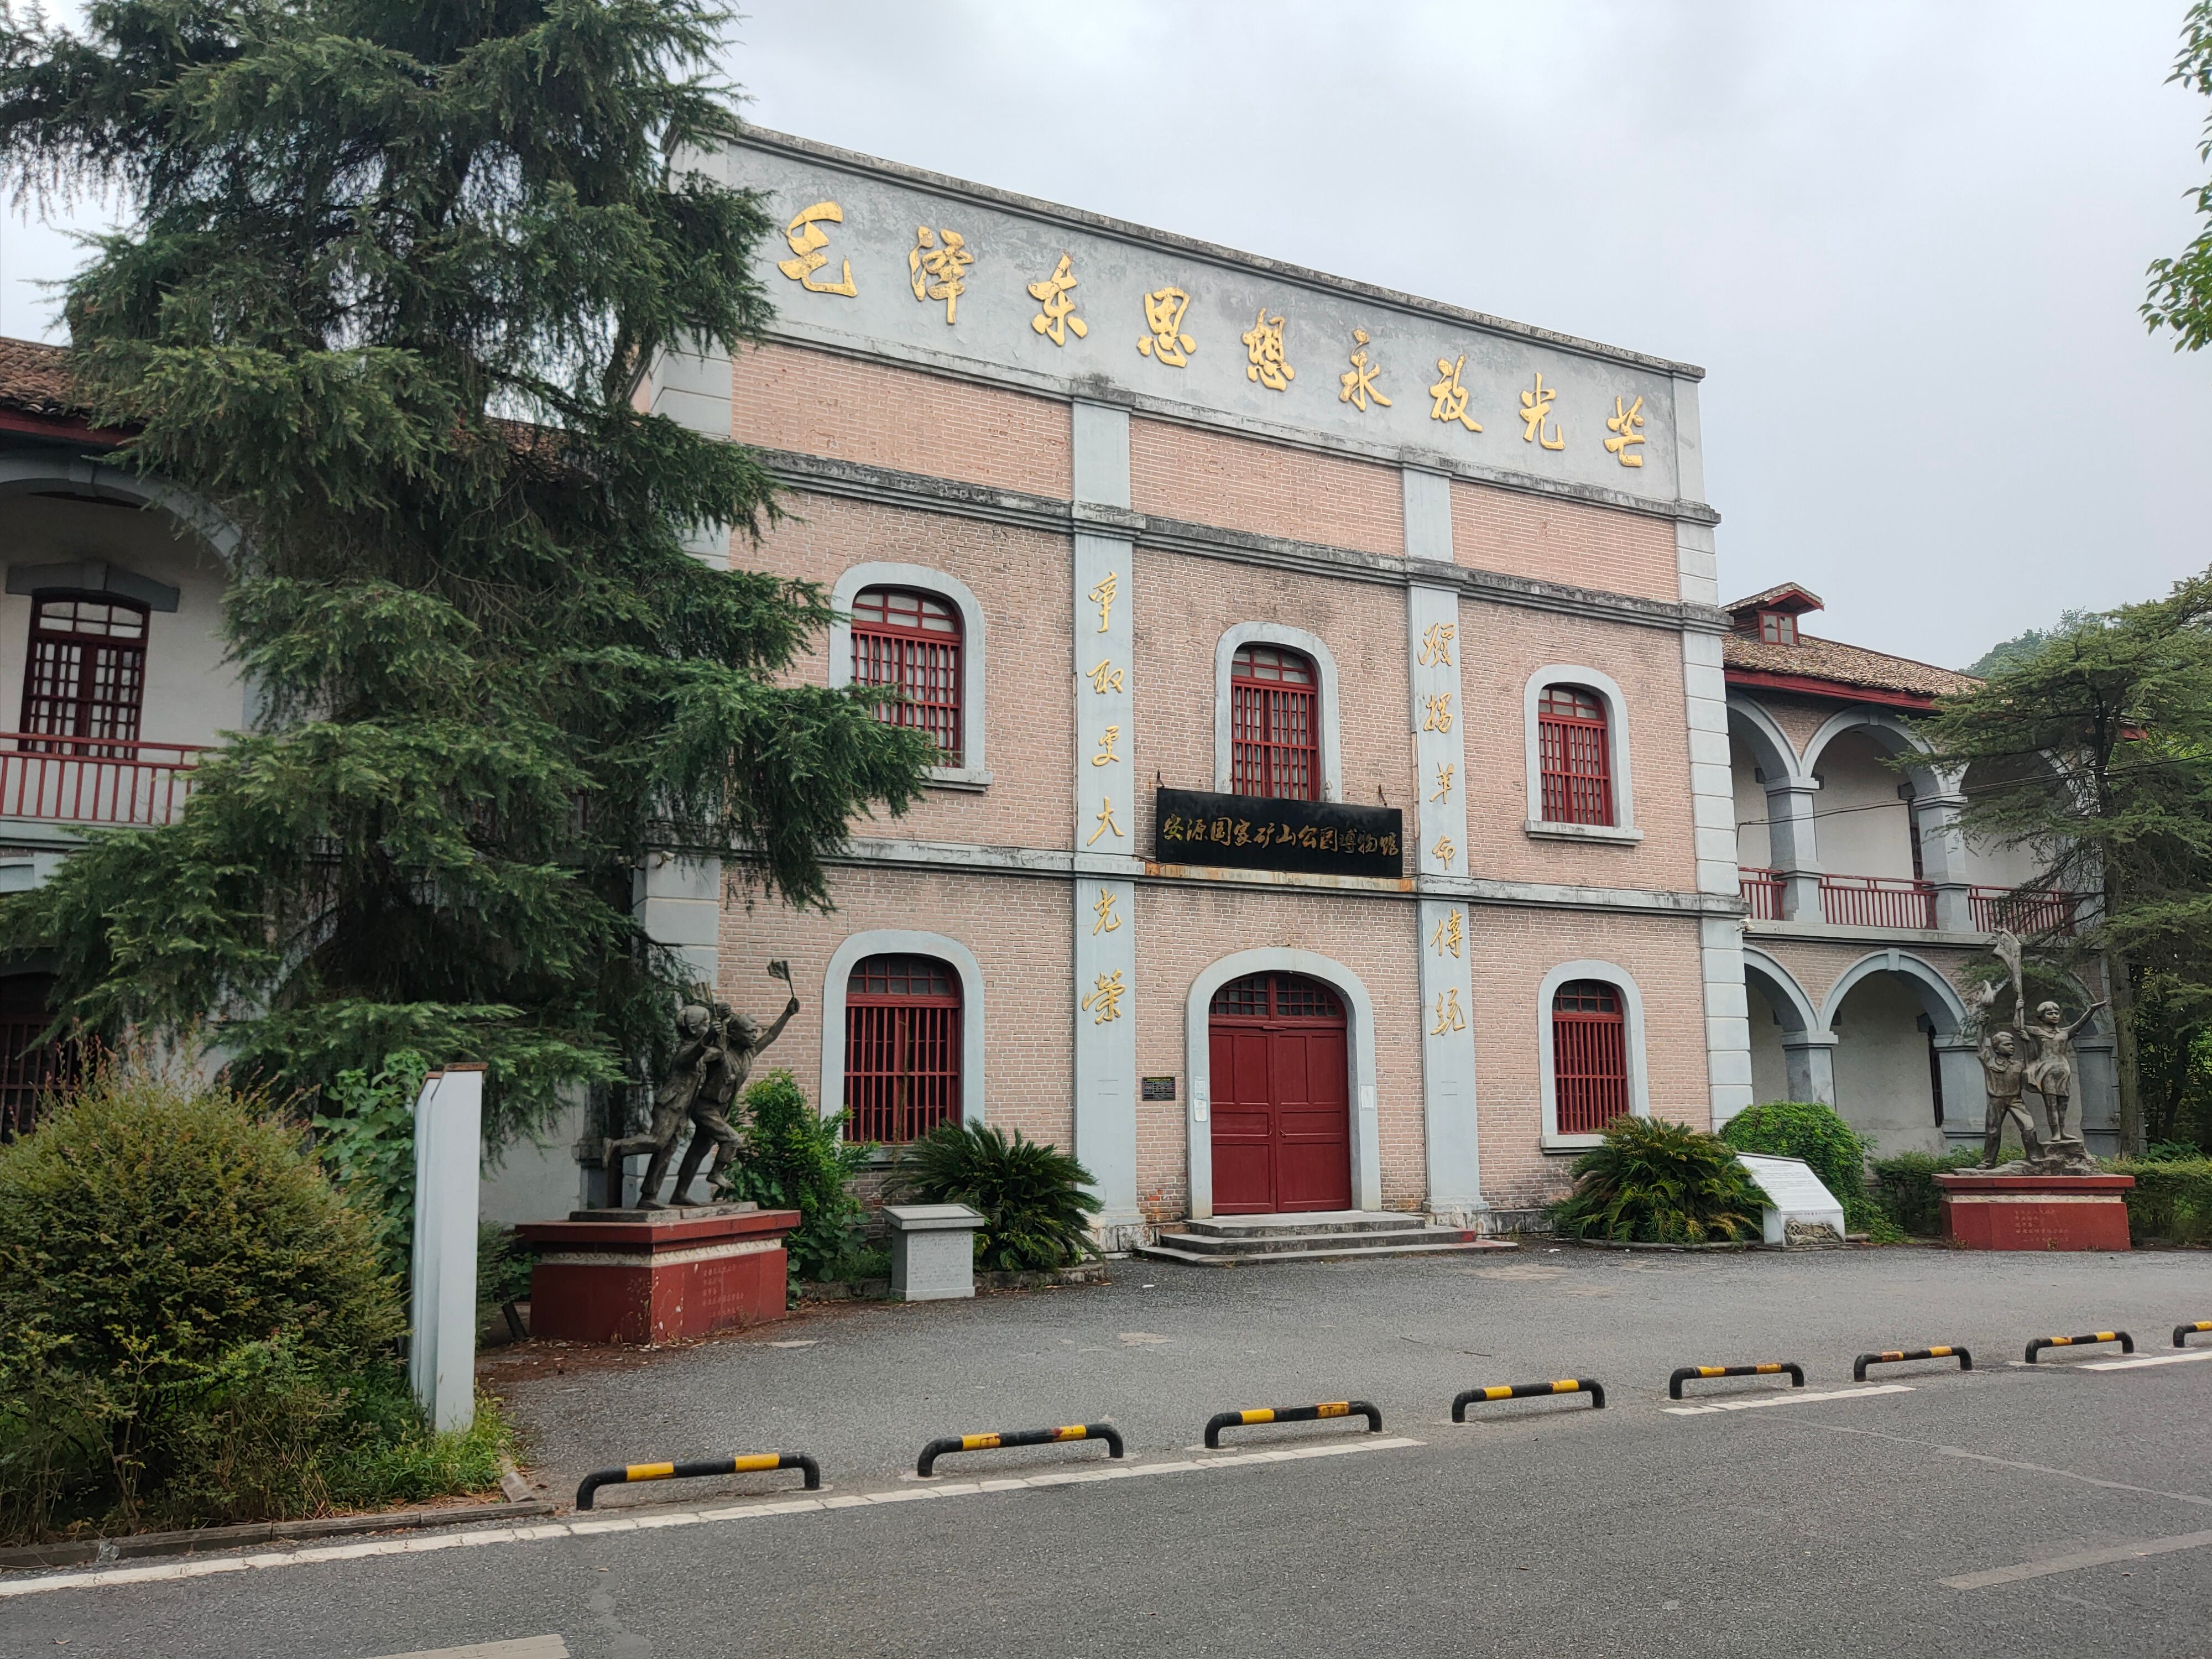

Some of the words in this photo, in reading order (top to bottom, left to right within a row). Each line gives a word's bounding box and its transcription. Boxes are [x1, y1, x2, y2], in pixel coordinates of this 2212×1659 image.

[777, 200, 1646, 468] 毛泽东思想永放光芒
